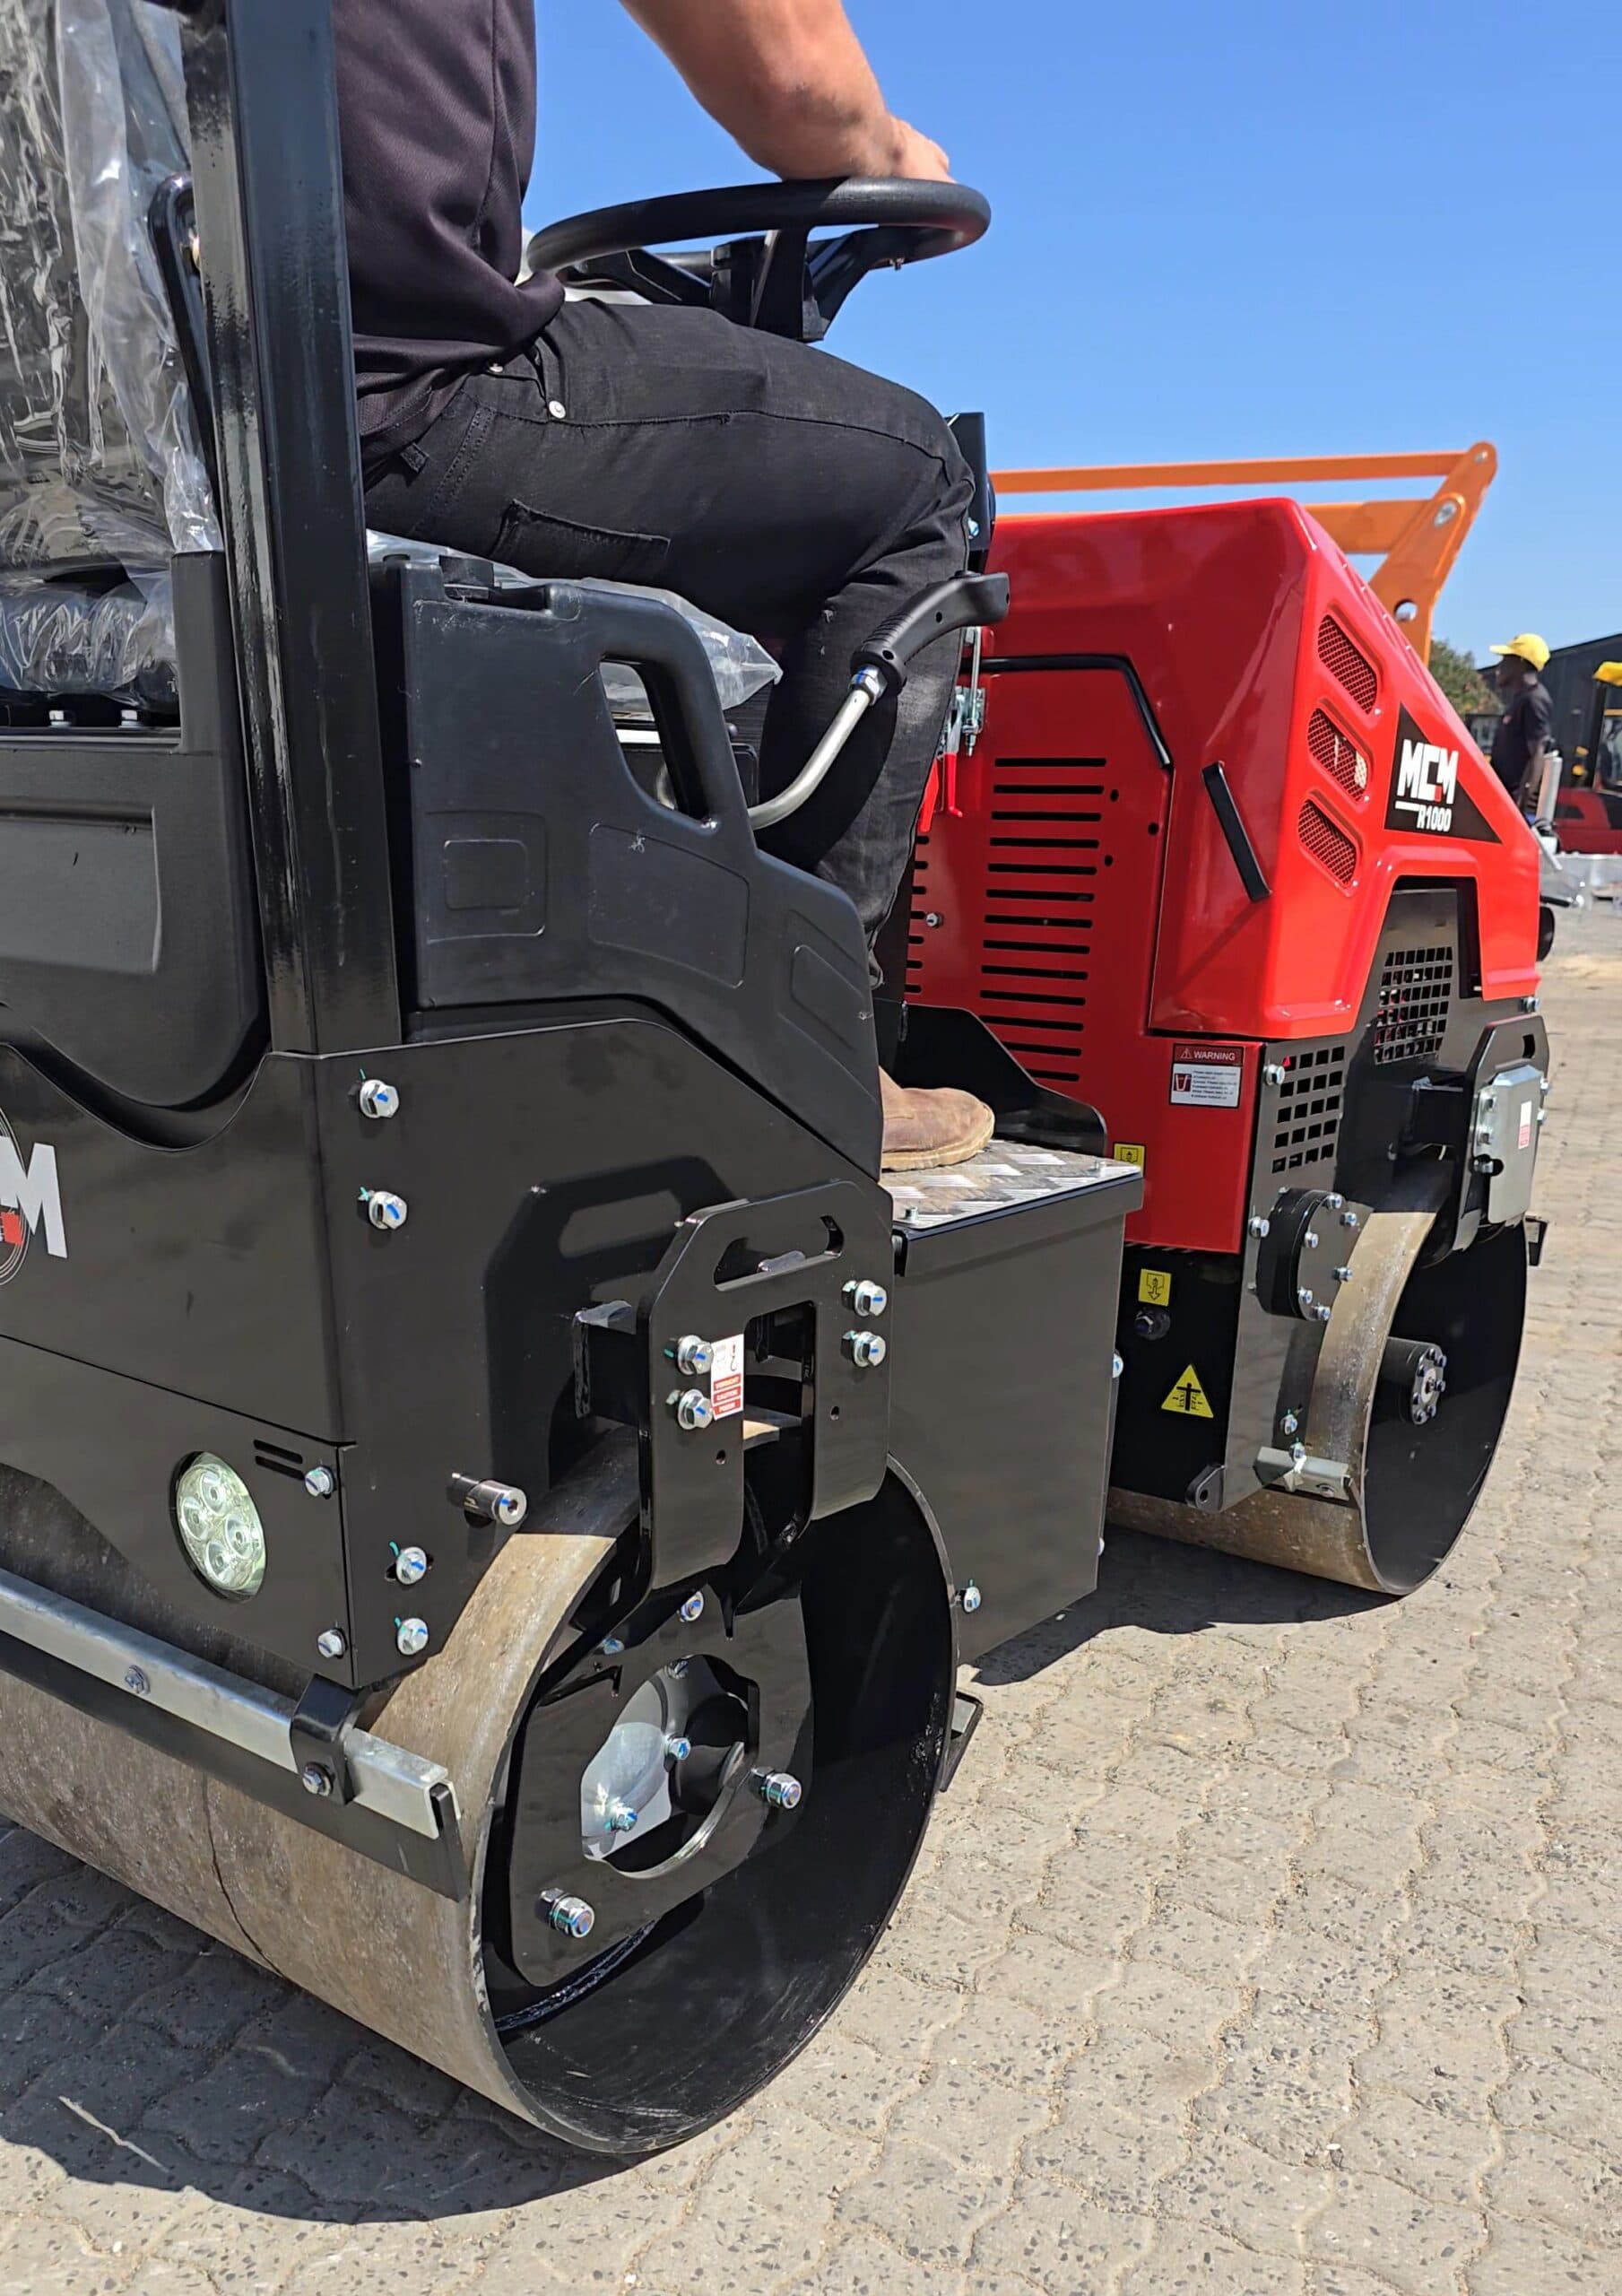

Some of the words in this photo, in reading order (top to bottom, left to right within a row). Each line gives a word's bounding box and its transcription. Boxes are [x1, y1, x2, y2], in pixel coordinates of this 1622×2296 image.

[1397, 738, 1459, 804] MCM
[1417, 804, 1452, 832] R1000
[1193, 1050, 1236, 1061] WARNING
